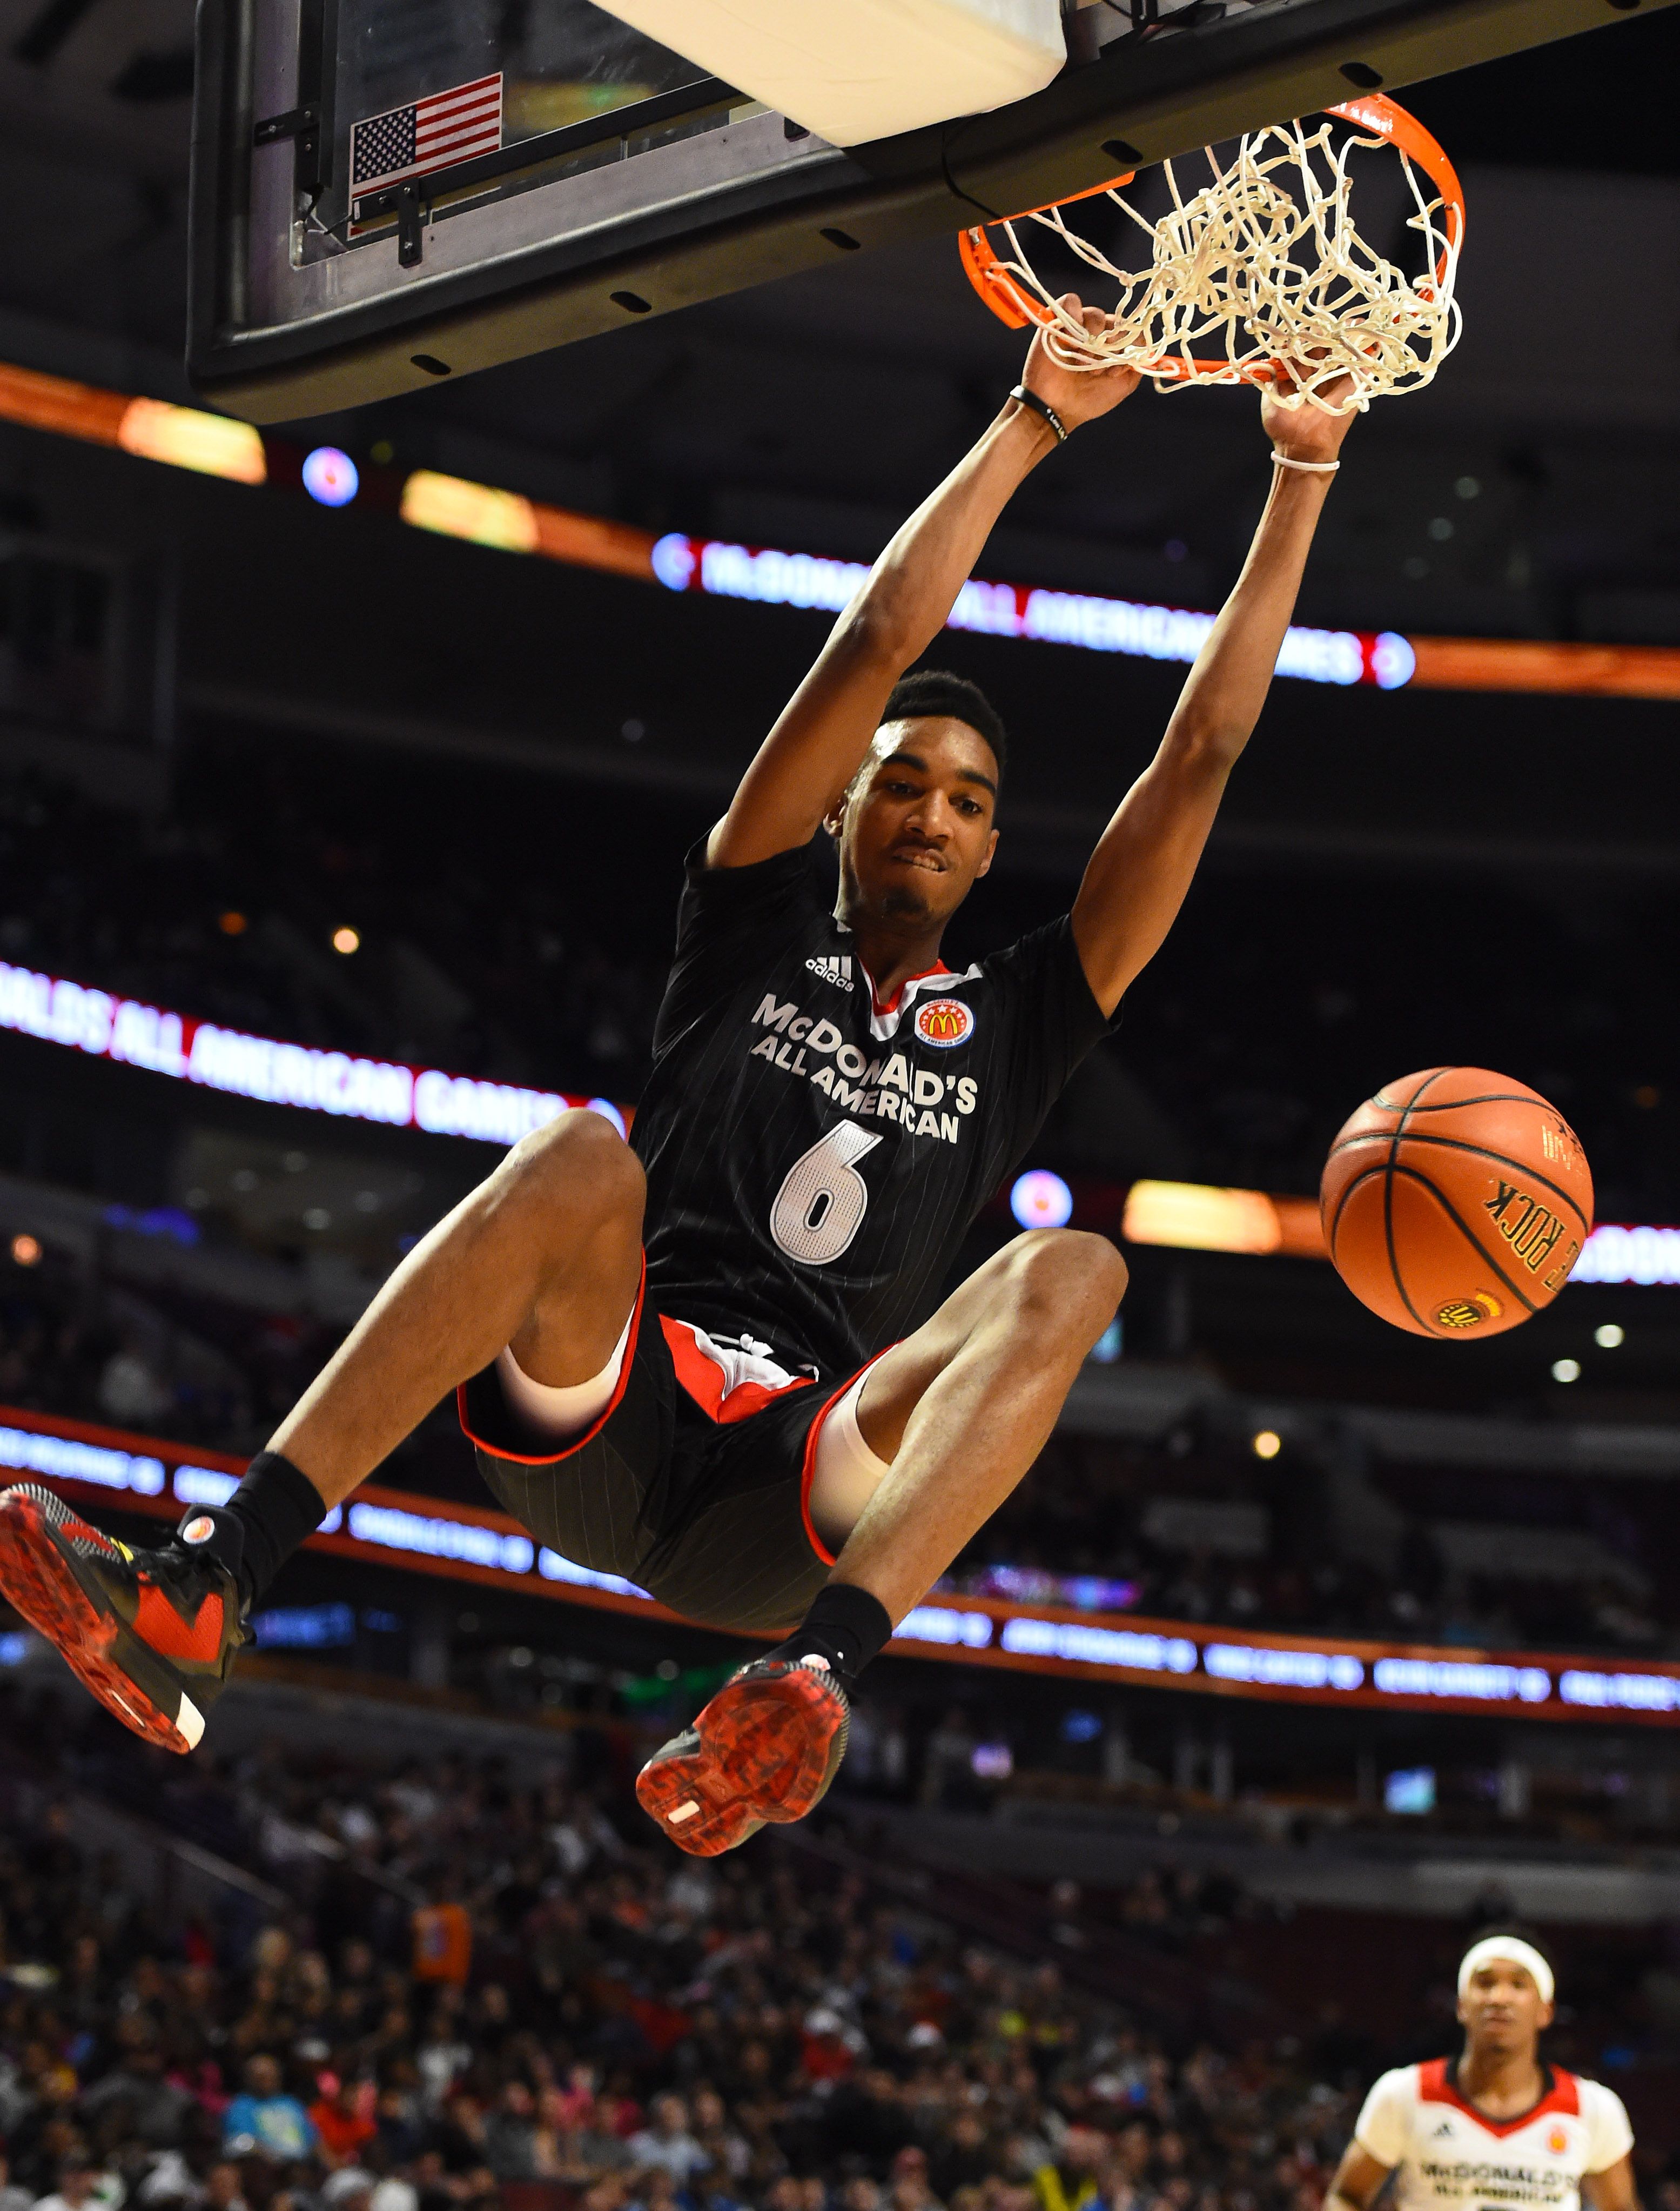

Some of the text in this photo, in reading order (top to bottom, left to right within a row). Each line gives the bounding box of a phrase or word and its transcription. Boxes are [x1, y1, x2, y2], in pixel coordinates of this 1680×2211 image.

[805, 959, 855, 992] adidas
[750, 1035, 959, 1144] ALL AMERICAN
[770, 1119, 884, 1265] 6
[1483, 1180, 1567, 1274] ROCK
